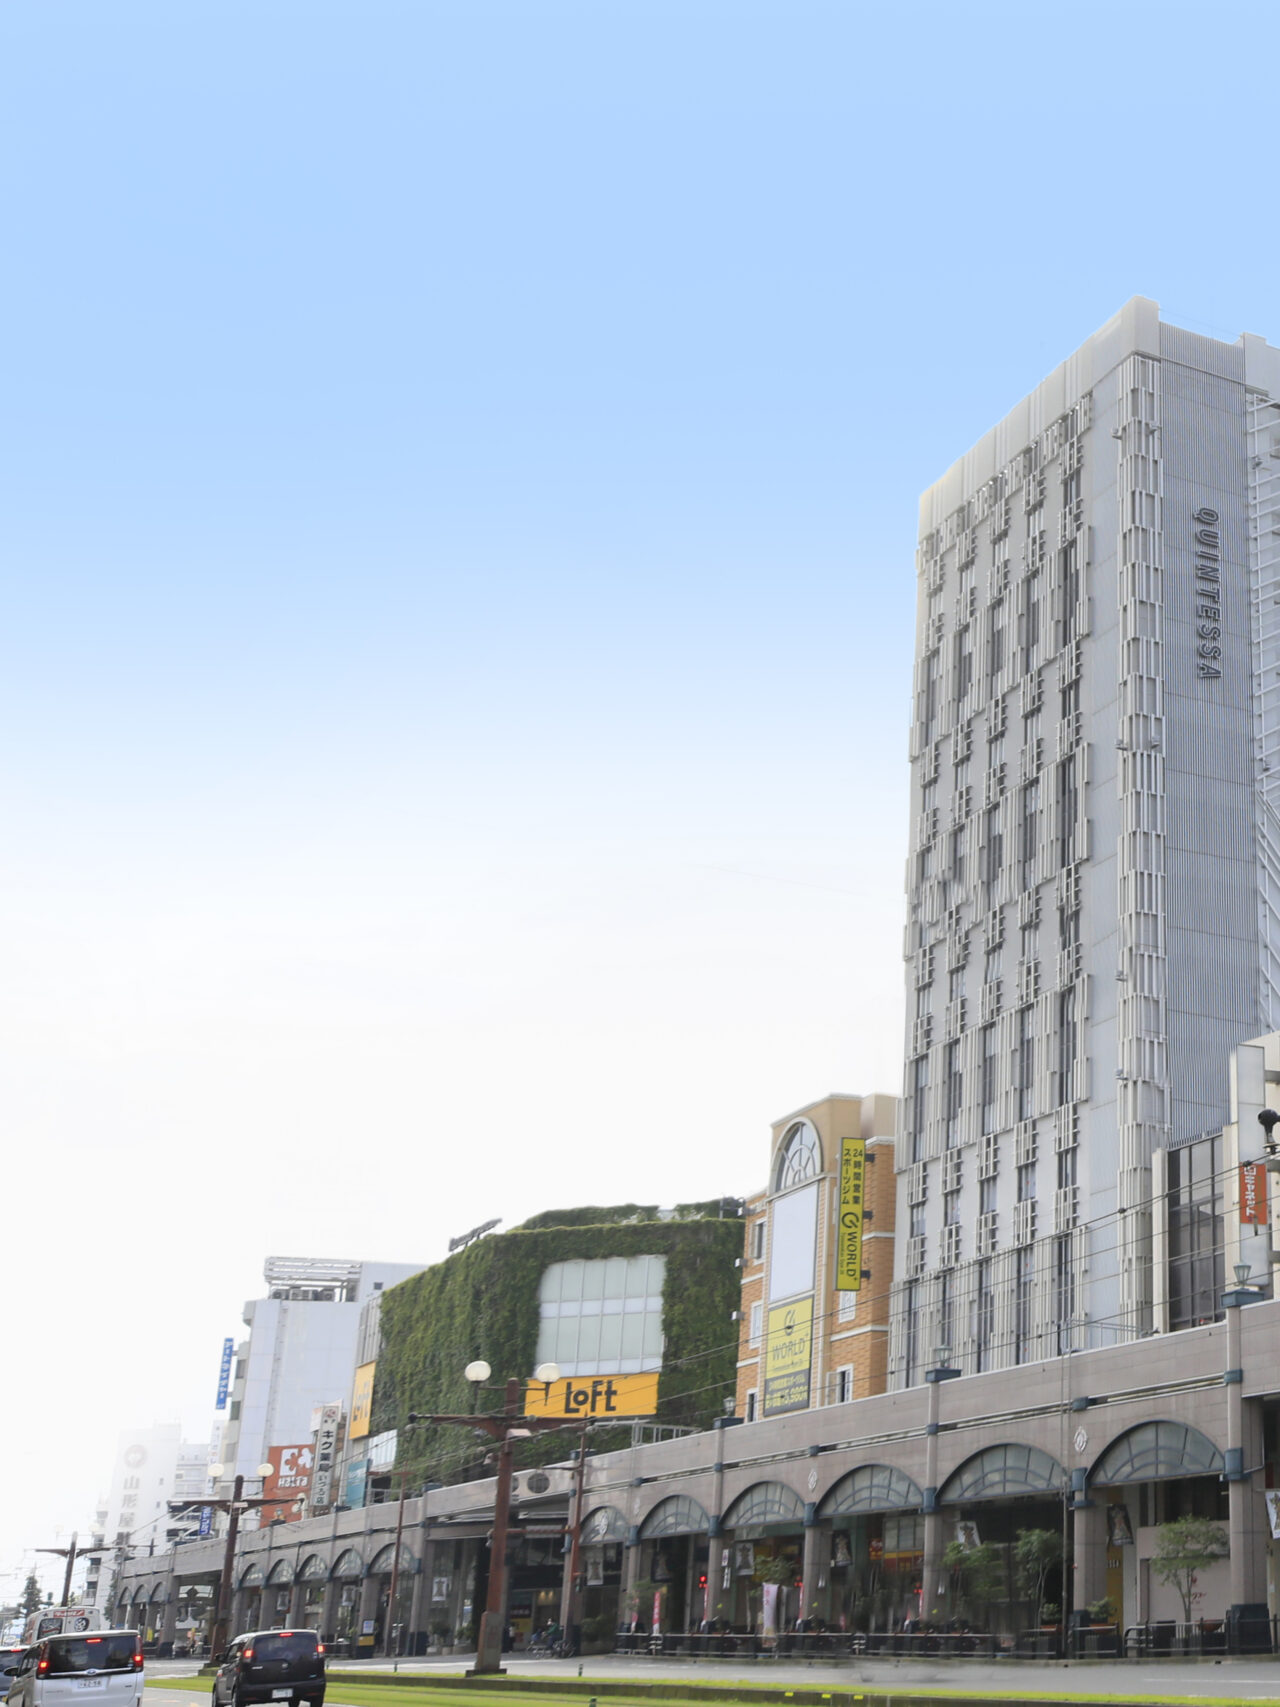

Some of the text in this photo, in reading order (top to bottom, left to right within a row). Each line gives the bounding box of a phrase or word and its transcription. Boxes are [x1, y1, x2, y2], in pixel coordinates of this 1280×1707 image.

[1193, 507, 1222, 679] QUINTESSA
[841, 1148, 852, 1205] スポーツジム
